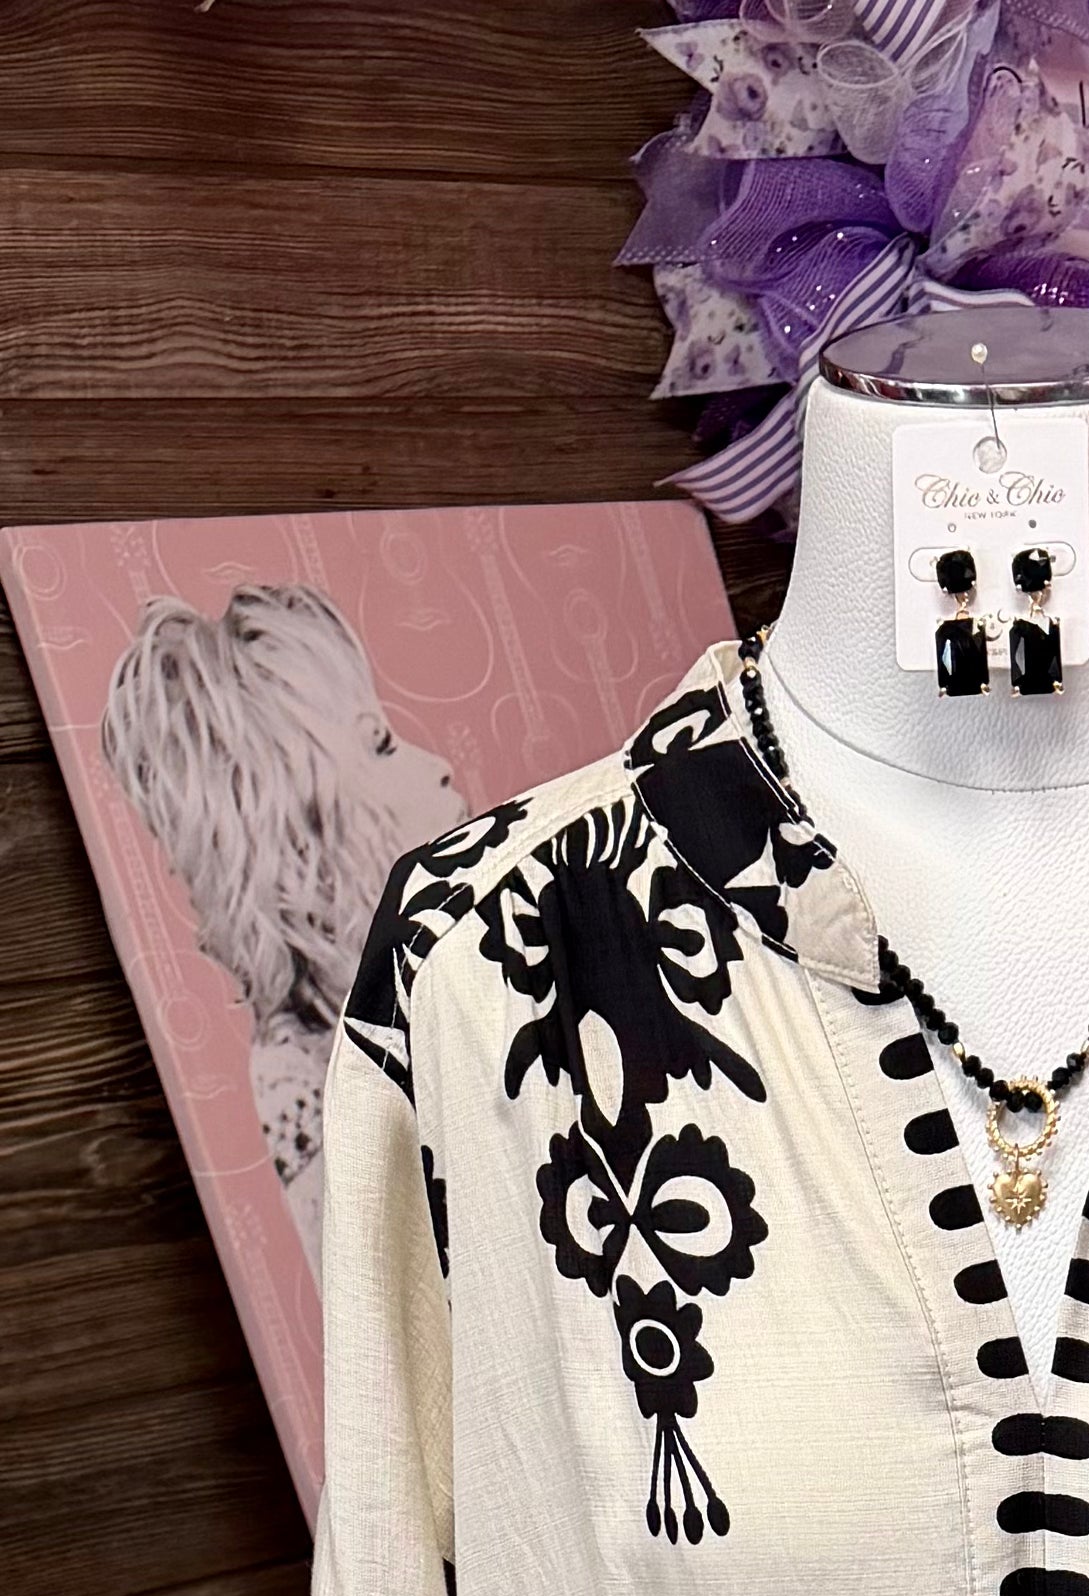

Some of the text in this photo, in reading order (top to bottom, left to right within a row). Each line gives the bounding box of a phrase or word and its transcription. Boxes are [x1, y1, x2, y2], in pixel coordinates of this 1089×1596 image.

[914, 470, 1067, 509] Chic & Chic
